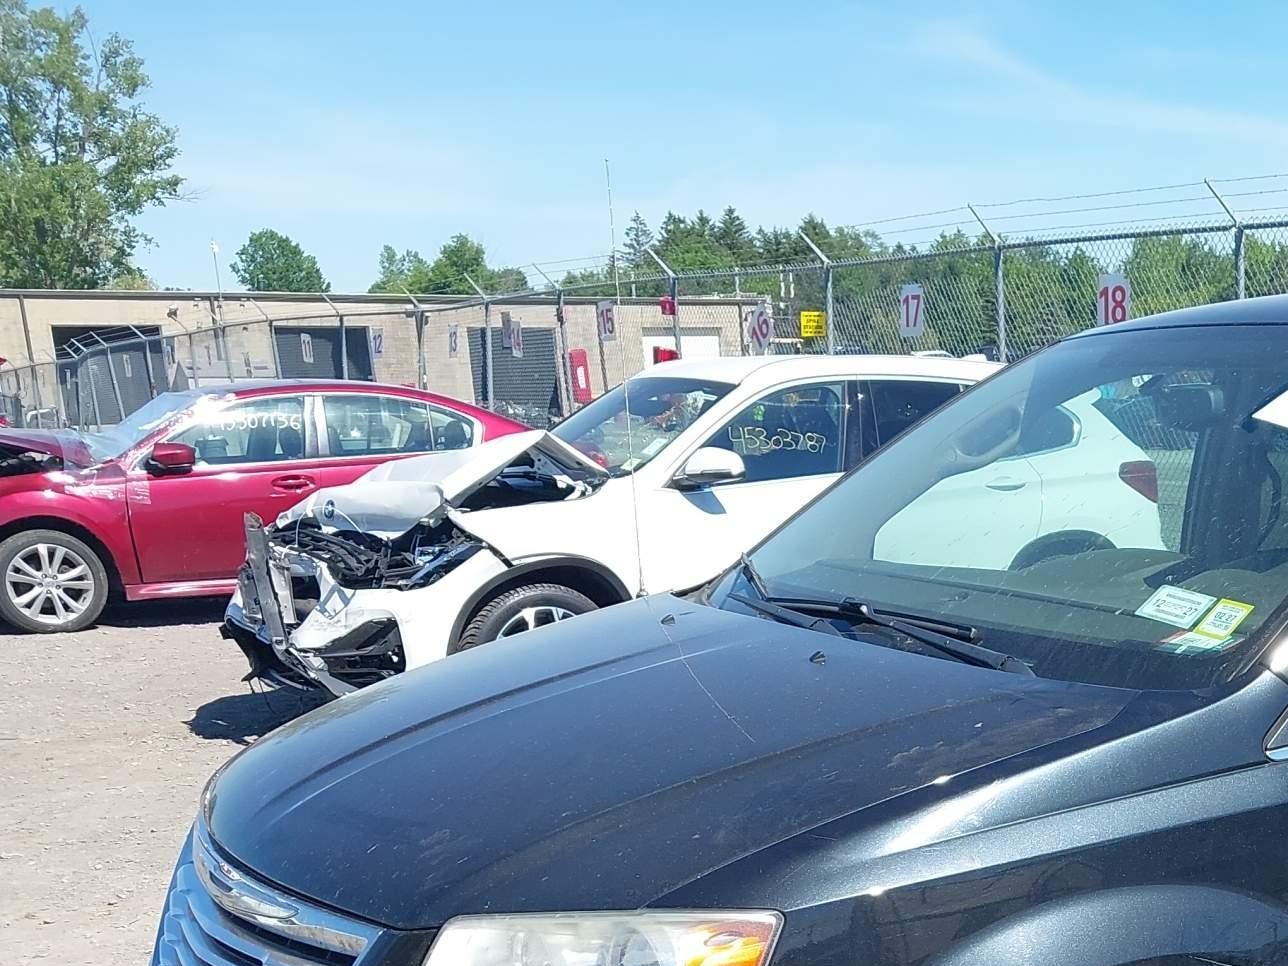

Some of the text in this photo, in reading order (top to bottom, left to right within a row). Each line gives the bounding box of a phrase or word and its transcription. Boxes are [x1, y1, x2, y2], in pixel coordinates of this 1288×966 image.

[902, 294, 921, 328] 17
[1098, 285, 1127, 326] 18
[600, 308, 614, 335] 15
[751, 310, 770, 350] 16
[302, 338, 312, 359] 11
[372, 334, 383, 354] 12
[728, 426, 826, 455] 45303787
